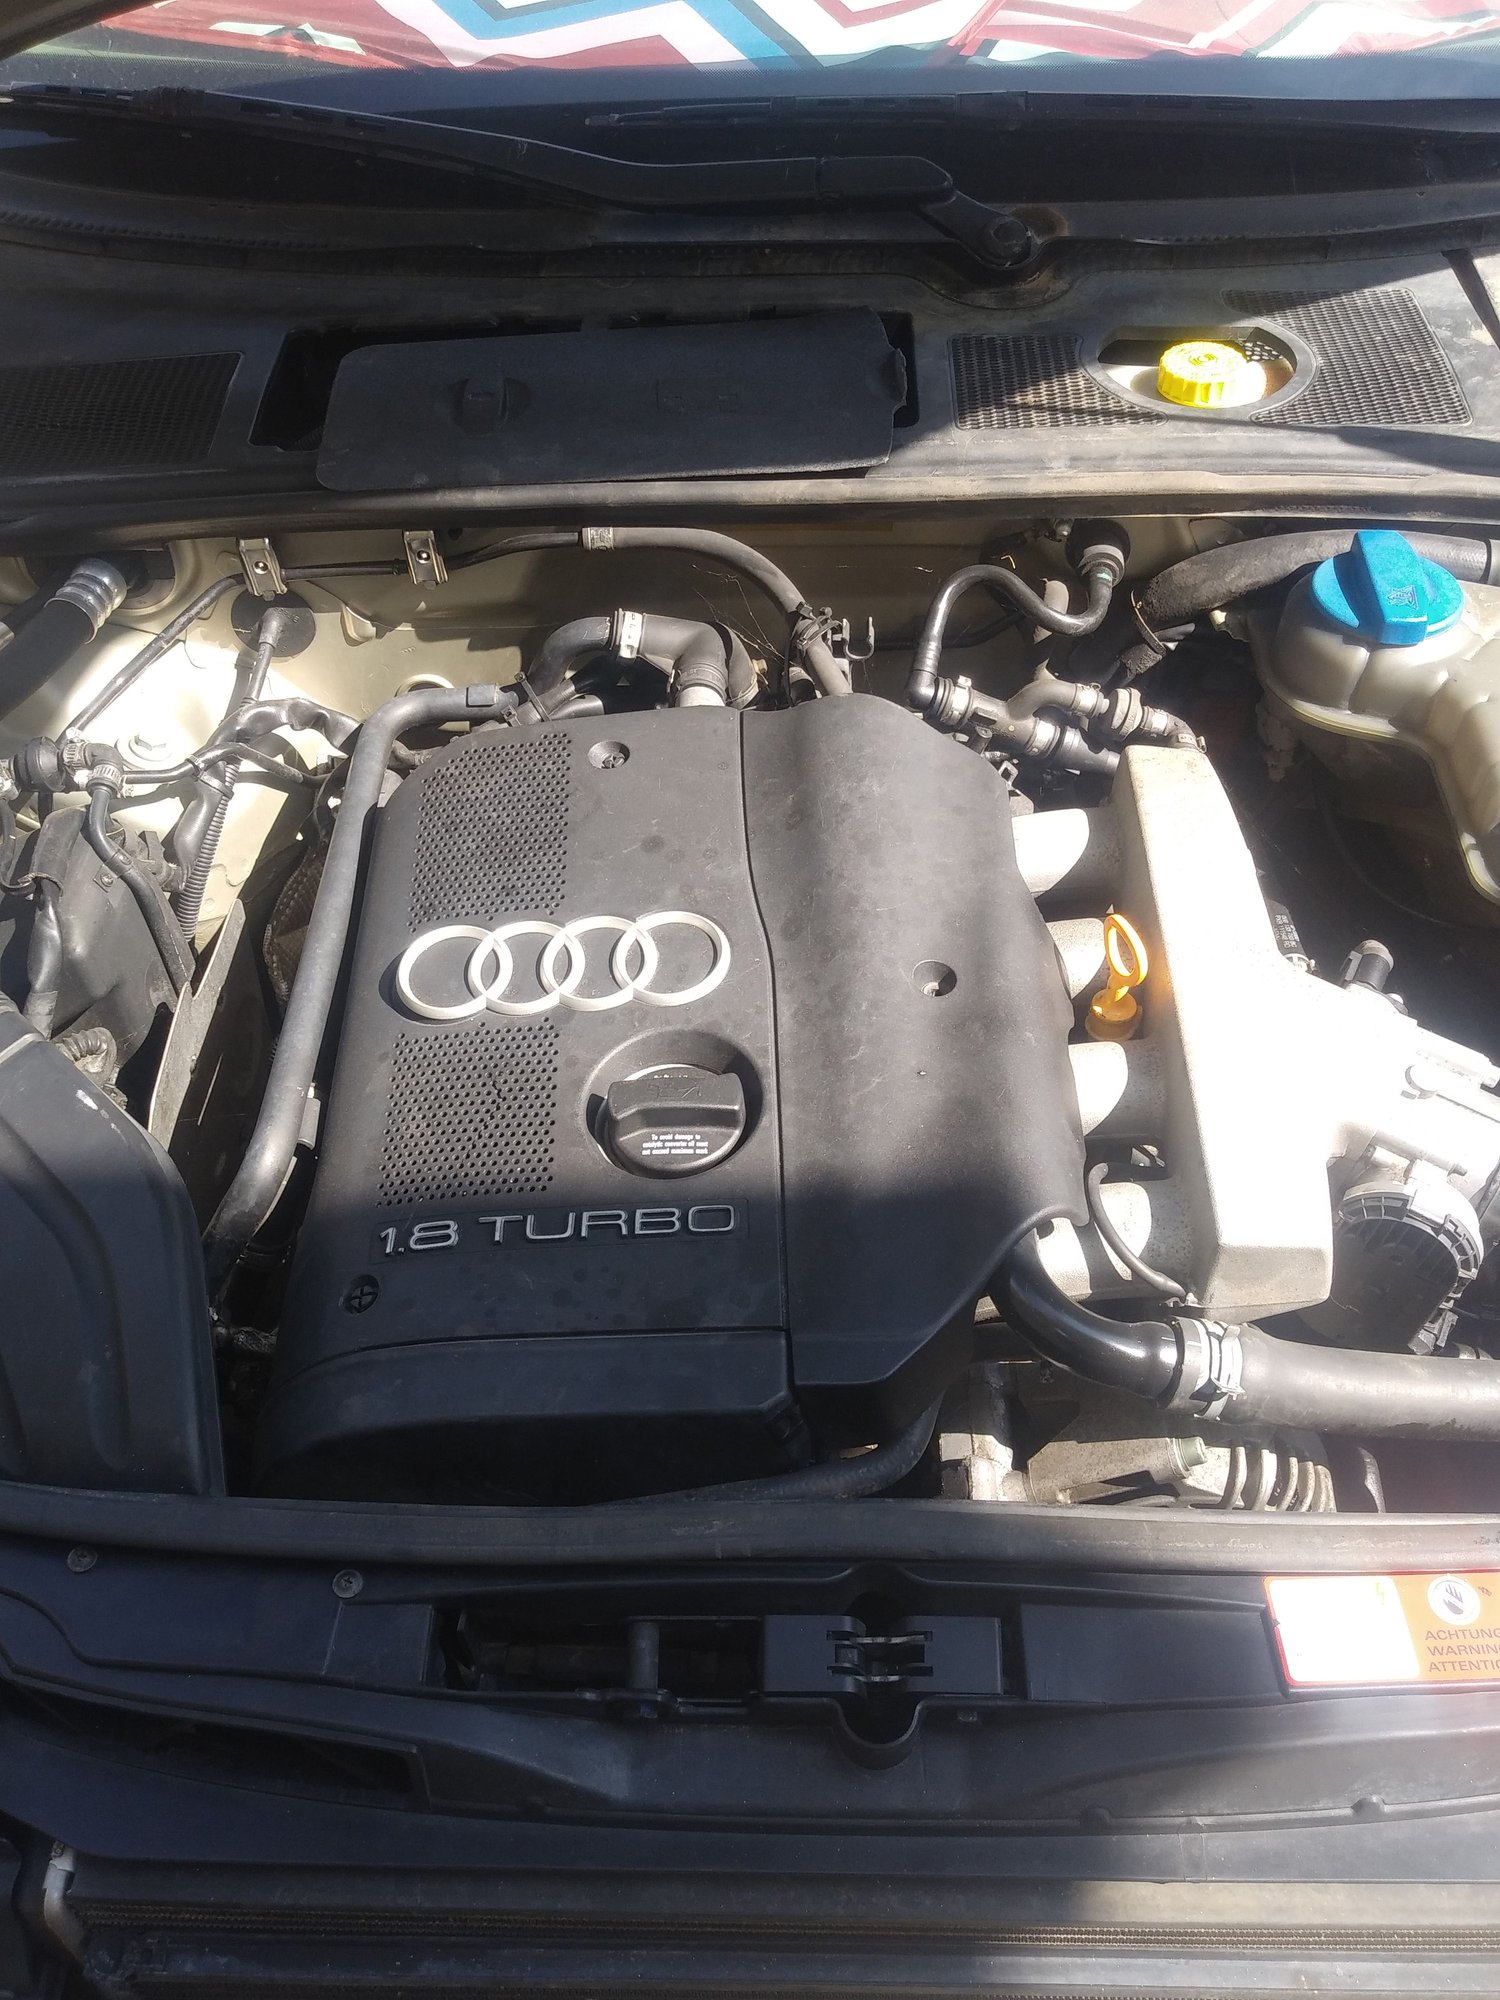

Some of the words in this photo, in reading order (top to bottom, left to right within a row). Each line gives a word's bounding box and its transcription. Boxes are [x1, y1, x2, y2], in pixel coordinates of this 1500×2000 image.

[674, 1133, 693, 1141] damage
[379, 1219, 460, 1255] 1.8
[478, 1204, 735, 1243] TURBO
[1425, 1628, 1500, 1641] ACHTUNG
[1426, 1643, 1500, 1656] WARNIN
